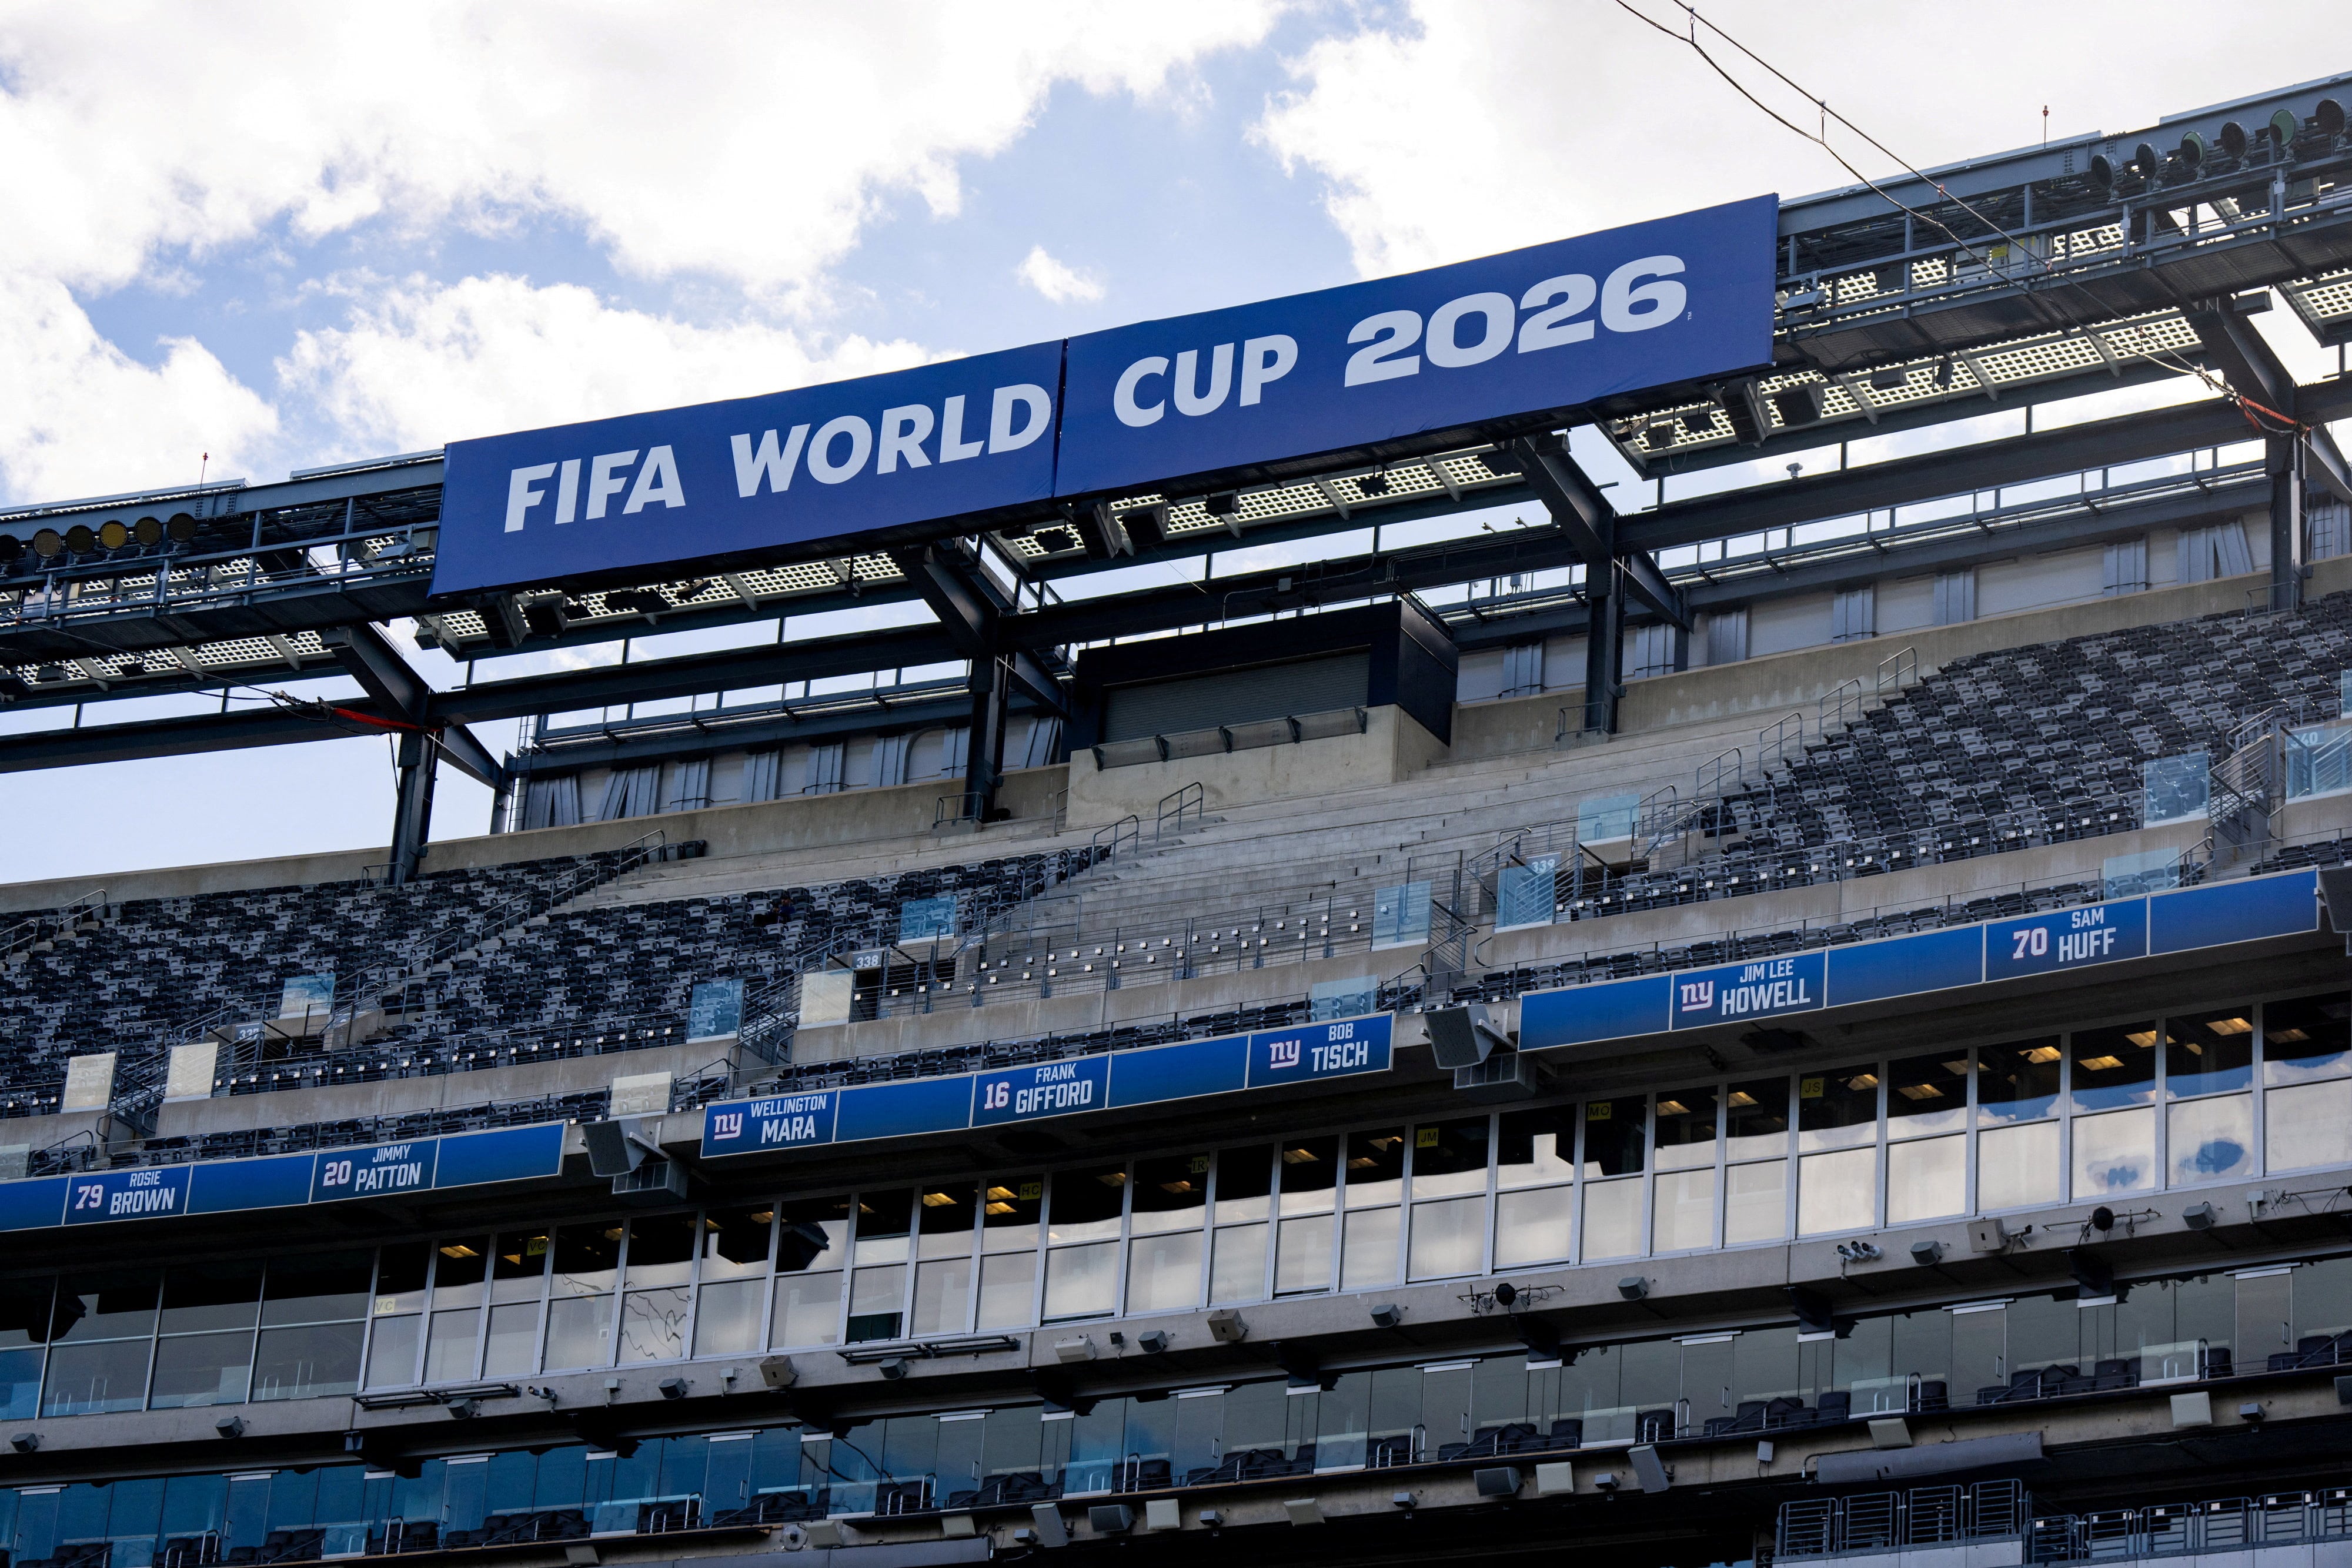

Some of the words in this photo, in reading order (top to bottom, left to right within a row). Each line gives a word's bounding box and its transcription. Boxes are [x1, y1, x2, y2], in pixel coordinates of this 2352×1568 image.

[504, 444, 686, 533] FIFA
[730, 383, 1051, 498] WORLD
[1113, 334, 1299, 427] CUP
[1344, 255, 1688, 387] 2026
[1532, 858, 1555, 873] 339
[2072, 908, 2104, 928] SAM
[2013, 927, 2047, 959] 70
[2059, 927, 2116, 962] HUFF
[857, 955, 878, 968] 338
[1740, 964, 1765, 983] JIM
[1769, 959, 1794, 978] LEE
[1722, 978, 1810, 1015] HOWELL
[239, 1028, 259, 1040] 337
[1328, 1023, 1354, 1041] BOB
[1311, 1041, 1368, 1072] TISCH
[1035, 1063, 1076, 1084] FRANK
[750, 1095, 827, 1118] WELLINGTON
[984, 1081, 1010, 1109] 16
[1015, 1079, 1093, 1114] GIFFORD
[1589, 1105, 1609, 1116] MO
[761, 1115, 816, 1144] MARA
[1421, 1132, 1436, 1143] JM
[372, 1144, 411, 1163] JIMMY
[129, 1171, 162, 1187] ROSIE
[323, 1160, 352, 1186] 20
[355, 1162, 422, 1192] PATTON
[75, 1184, 103, 1209] 79
[109, 1187, 175, 1215] BROWN
[1022, 1185, 1039, 1196] HC
[530, 1241, 546, 1252] VC
[376, 1300, 393, 1312] VC
